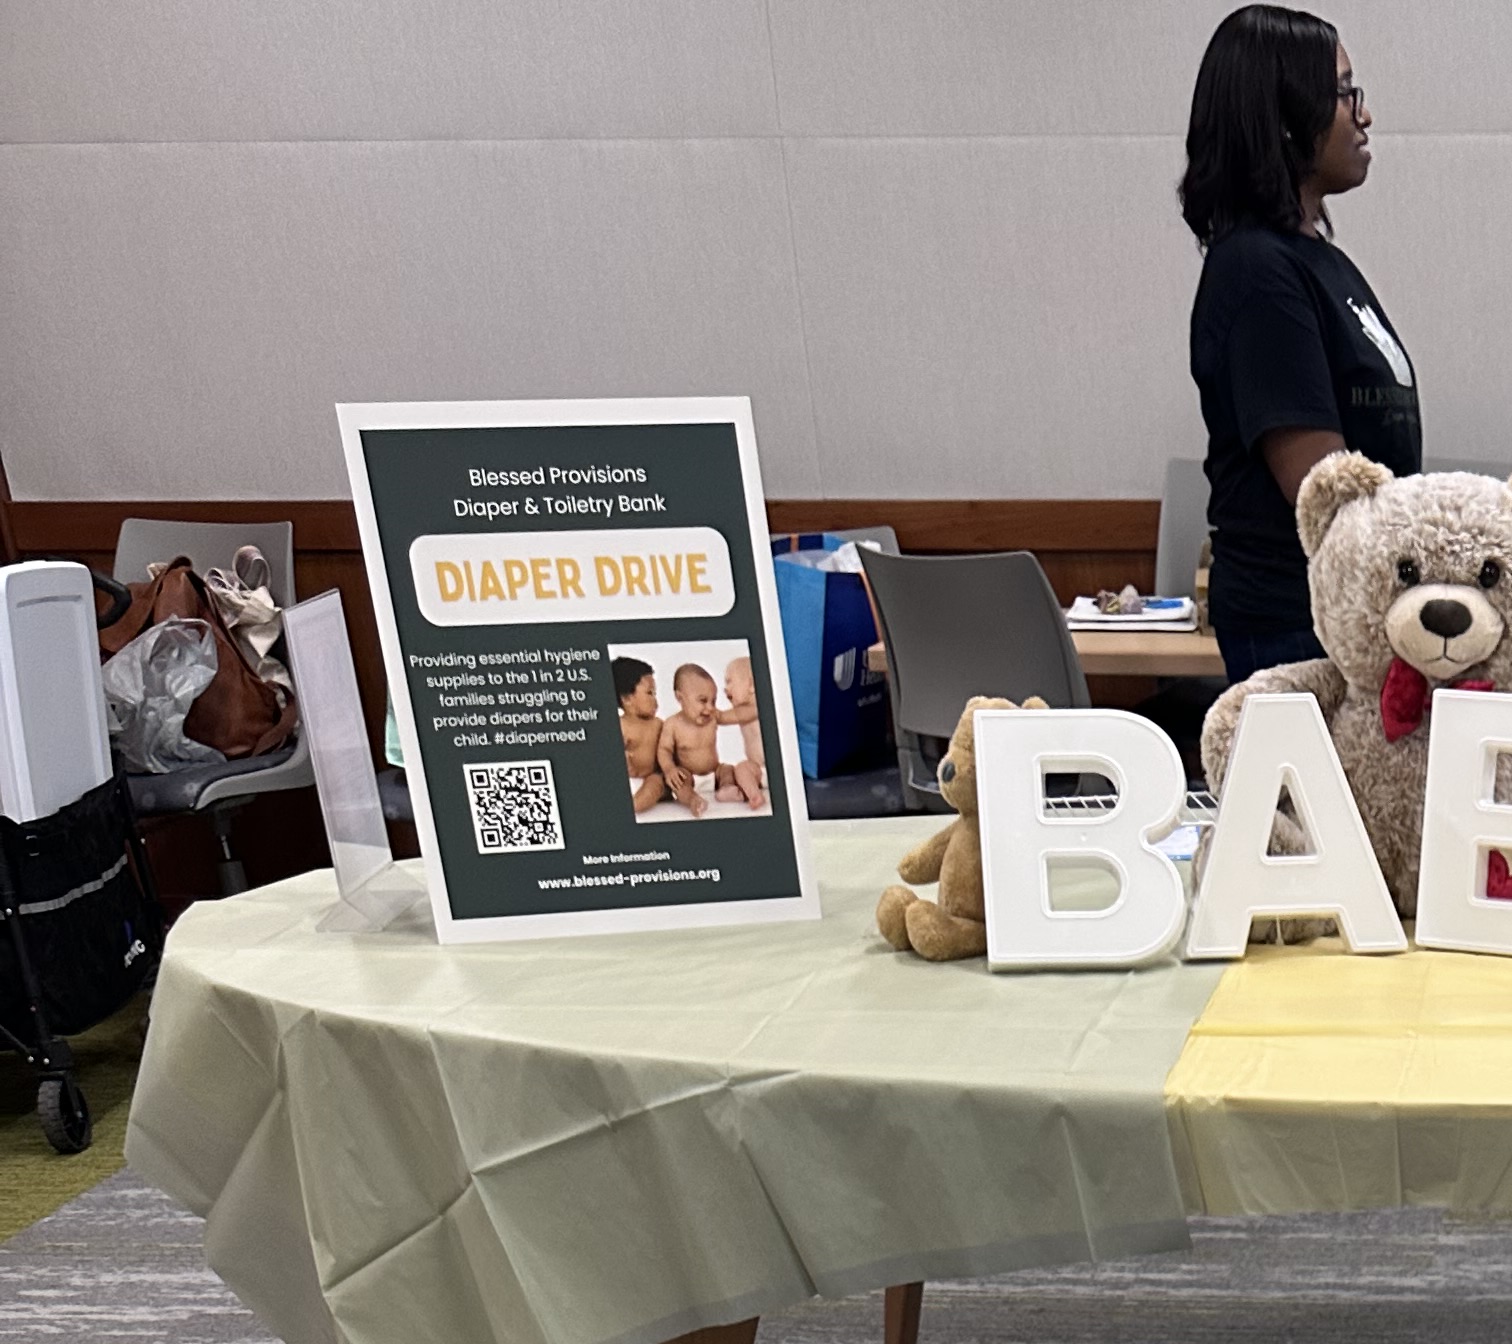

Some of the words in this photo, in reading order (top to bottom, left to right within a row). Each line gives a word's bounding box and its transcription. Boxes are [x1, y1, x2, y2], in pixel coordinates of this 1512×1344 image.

[469, 467, 545, 486] Blessed
[549, 465, 647, 484] Provisions
[454, 498, 519, 520] Diaper
[525, 498, 539, 514] &
[543, 496, 614, 517] Toiletry
[619, 494, 666, 512] Bank
[435, 558, 585, 602] DIAPER
[594, 554, 712, 597] DRIVE
[410, 653, 476, 669] Providing
[479, 650, 542, 665] essential
[544, 648, 600, 665] hygiene
[427, 674, 485, 690] supplies
[488, 673, 503, 684] to
[506, 670, 529, 683] the
[531, 670, 537, 683] 1
[540, 670, 553, 682] in
[556, 669, 564, 682] 2
[567, 669, 592, 681] U.S.
[440, 694, 495, 707] families
[499, 690, 568, 706] struggling
[571, 689, 586, 701] to
[433, 713, 486, 731] provide
[490, 711, 542, 727] diapers
[545, 709, 563, 722] for
[568, 708, 598, 721] their
[454, 733, 492, 747] child.
[495, 728, 586, 746] #diaperneed
[583, 855, 609, 865] More
[610, 851, 670, 863] Information
[538, 868, 720, 889] www.blessed-provisions.org
